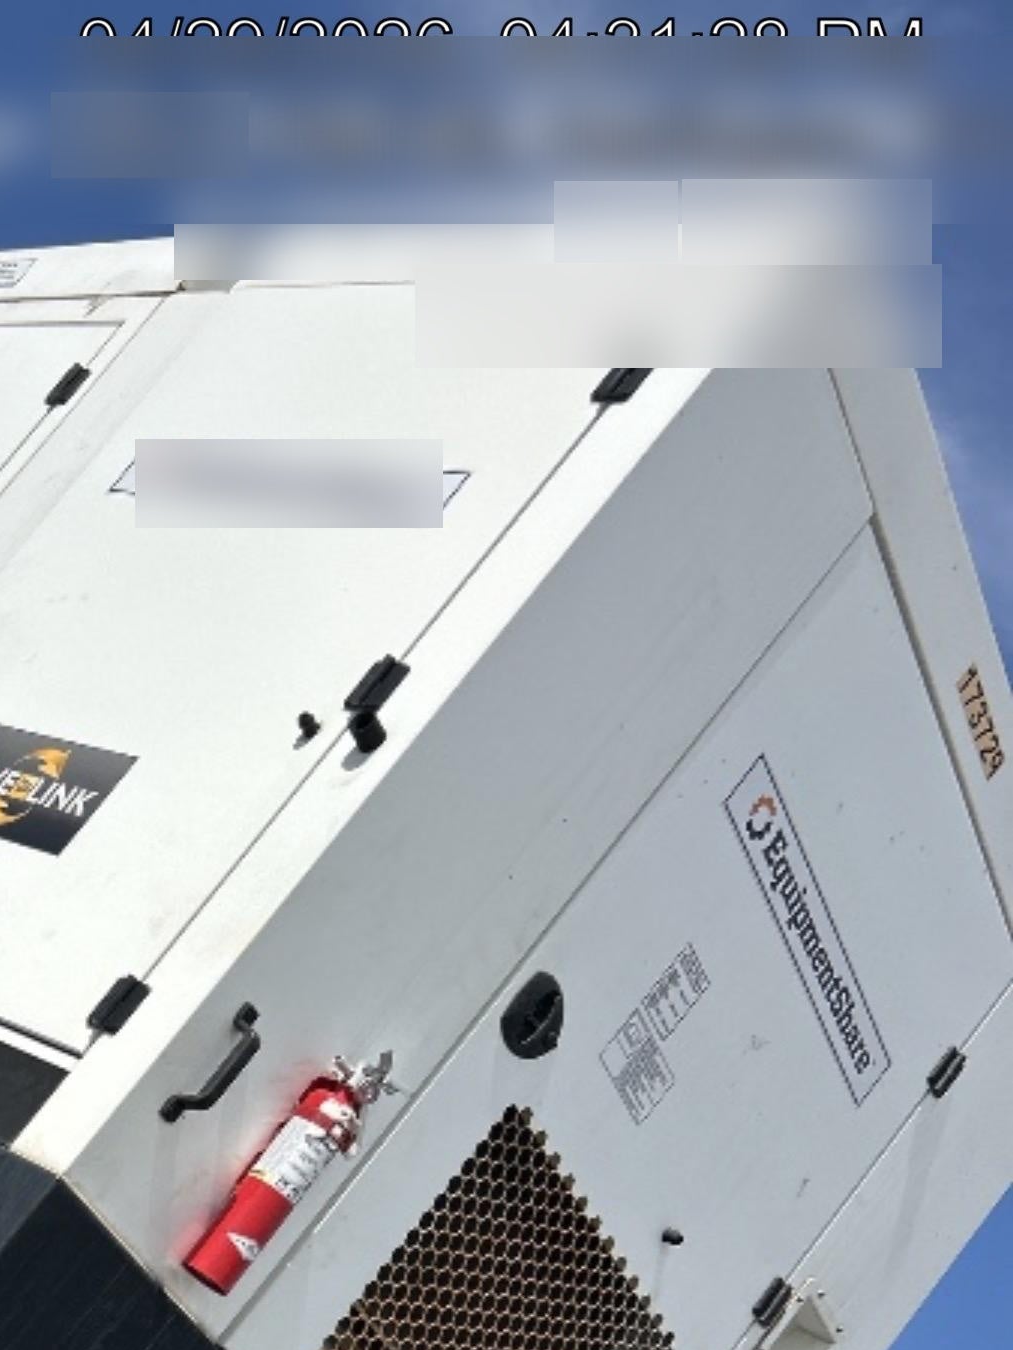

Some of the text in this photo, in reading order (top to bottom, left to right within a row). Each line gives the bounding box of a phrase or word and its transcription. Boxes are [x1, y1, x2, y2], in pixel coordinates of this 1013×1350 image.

[955, 664, 1005, 781] 173729
[27, 775, 100, 818] LINK
[761, 831, 874, 1075] EquipmentShare
